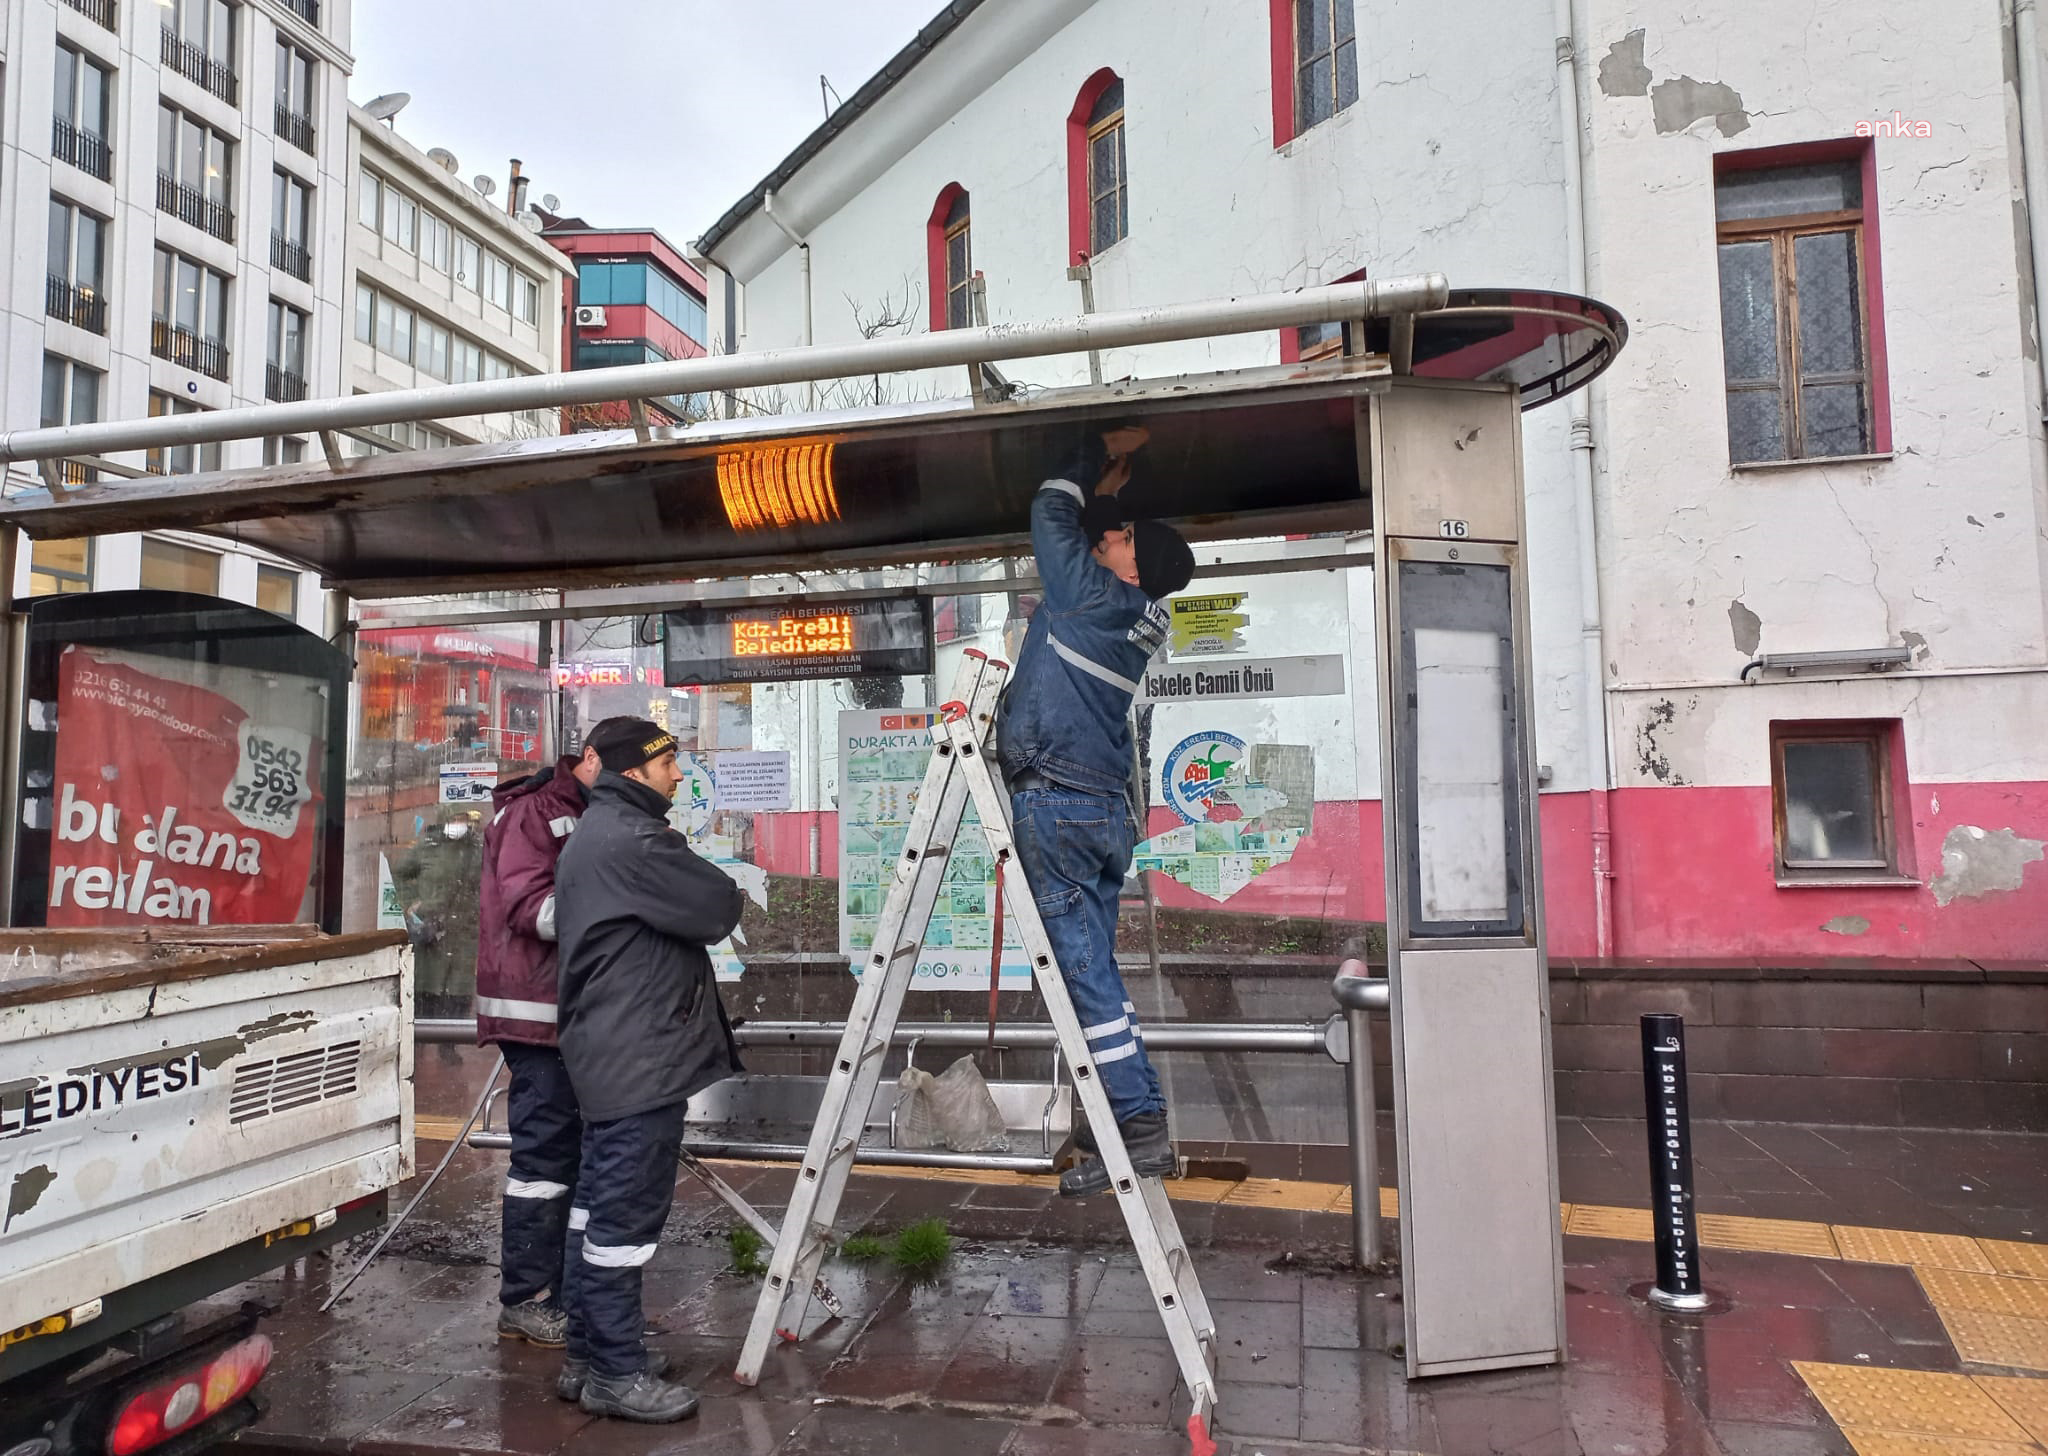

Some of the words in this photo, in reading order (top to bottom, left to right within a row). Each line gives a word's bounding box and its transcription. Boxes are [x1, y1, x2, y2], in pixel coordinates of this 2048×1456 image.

[1443, 521, 1465, 536] 16
[735, 634, 852, 656] Belediyesi
[1145, 671, 1192, 697] İskele
[1195, 670, 1239, 695] Camii
[1243, 665, 1274, 693] Önü
[247, 735, 301, 776] 0542
[849, 735, 917, 749] DURAKTA
[252, 763, 297, 796] 563
